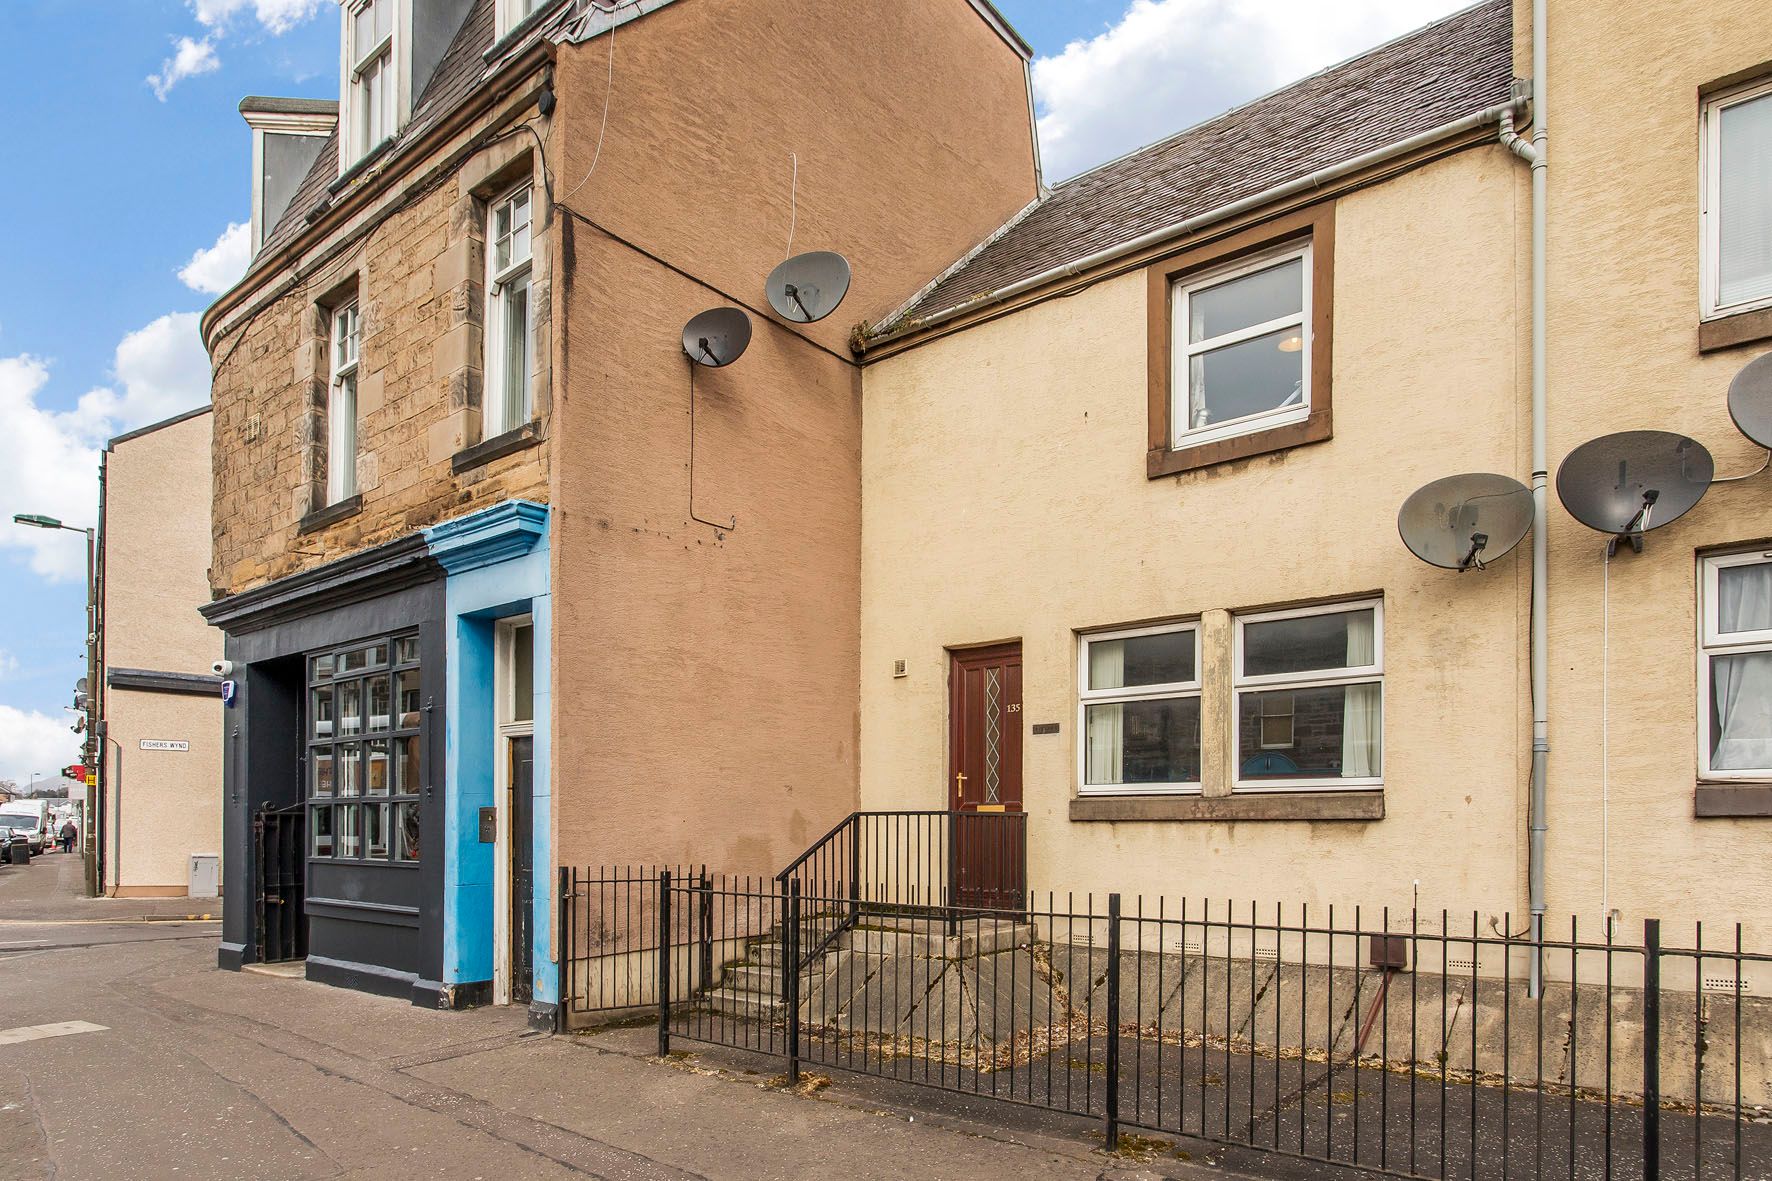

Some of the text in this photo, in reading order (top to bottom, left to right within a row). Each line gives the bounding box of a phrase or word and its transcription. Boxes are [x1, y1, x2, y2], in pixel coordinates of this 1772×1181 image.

[1006, 703, 1021, 713] 135
[142, 741, 168, 749] FISHERS
[87, 775, 96, 785] H
